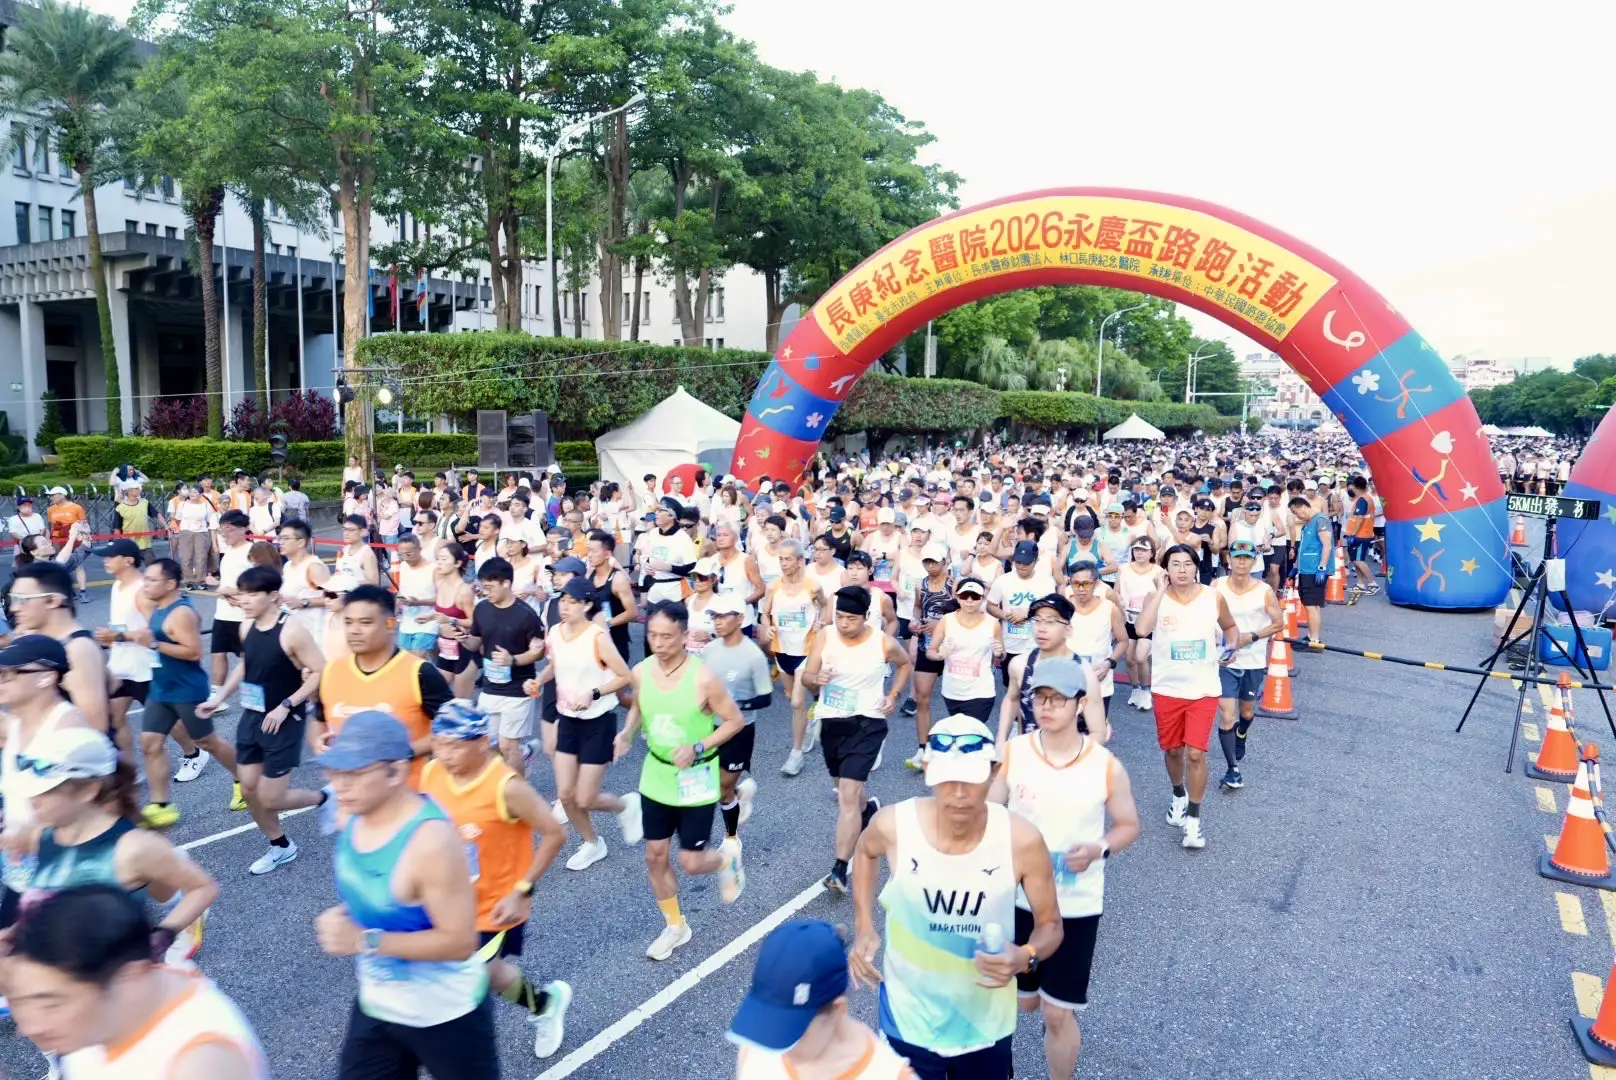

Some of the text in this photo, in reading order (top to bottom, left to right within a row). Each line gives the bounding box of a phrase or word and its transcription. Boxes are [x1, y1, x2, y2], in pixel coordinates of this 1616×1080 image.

[825, 211, 1309, 336] 長庚紀念醫院2026永慶盃路跑活動
[929, 923, 981, 933] MARATHON
